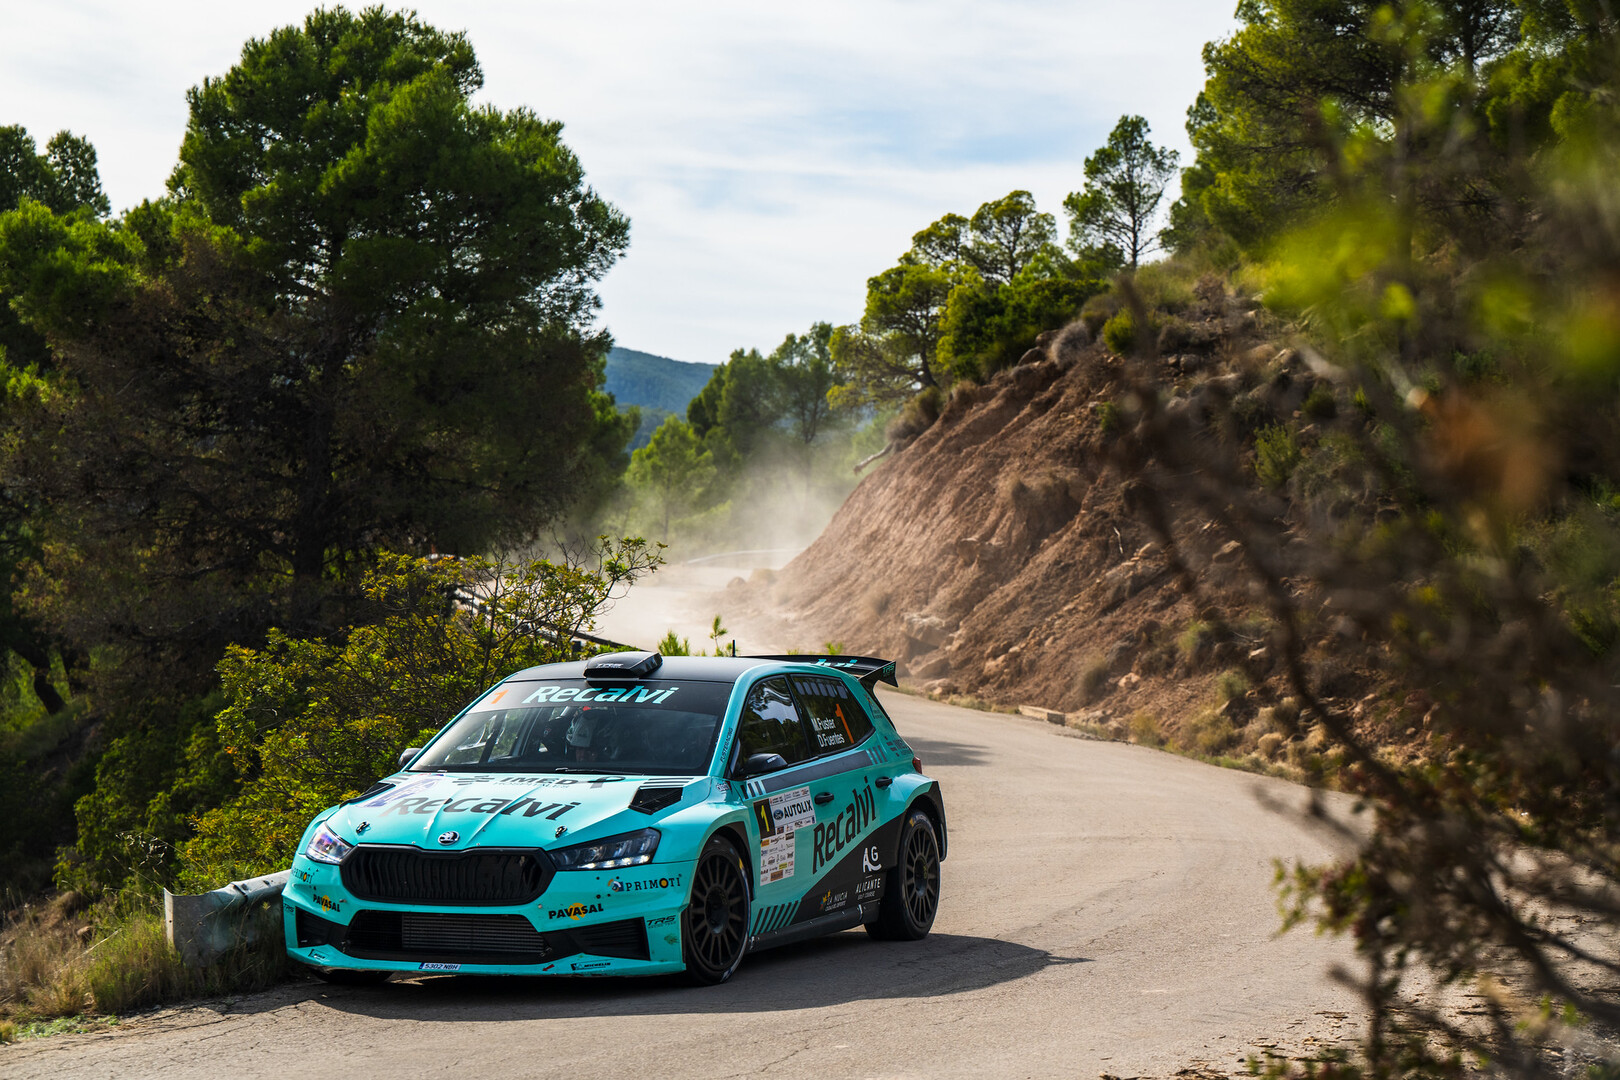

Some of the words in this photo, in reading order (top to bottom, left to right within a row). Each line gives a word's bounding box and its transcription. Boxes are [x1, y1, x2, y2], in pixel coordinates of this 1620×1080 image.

[490, 688, 509, 705] 1
[522, 685, 680, 705] Recalvi
[835, 703, 855, 744] 1
[816, 732, 846, 748] D.Fuentes
[378, 797, 582, 821] Recalvi
[760, 804, 770, 832] 1
[783, 800, 813, 819] AUTOLIX
[812, 775, 877, 875] Recalvi
[625, 877, 681, 892] PRIMOTI
[855, 878, 881, 895] ALICANTE
[312, 894, 341, 913] PAVASAL
[548, 903, 604, 920] PAVASAL
[646, 915, 677, 926] TRS
